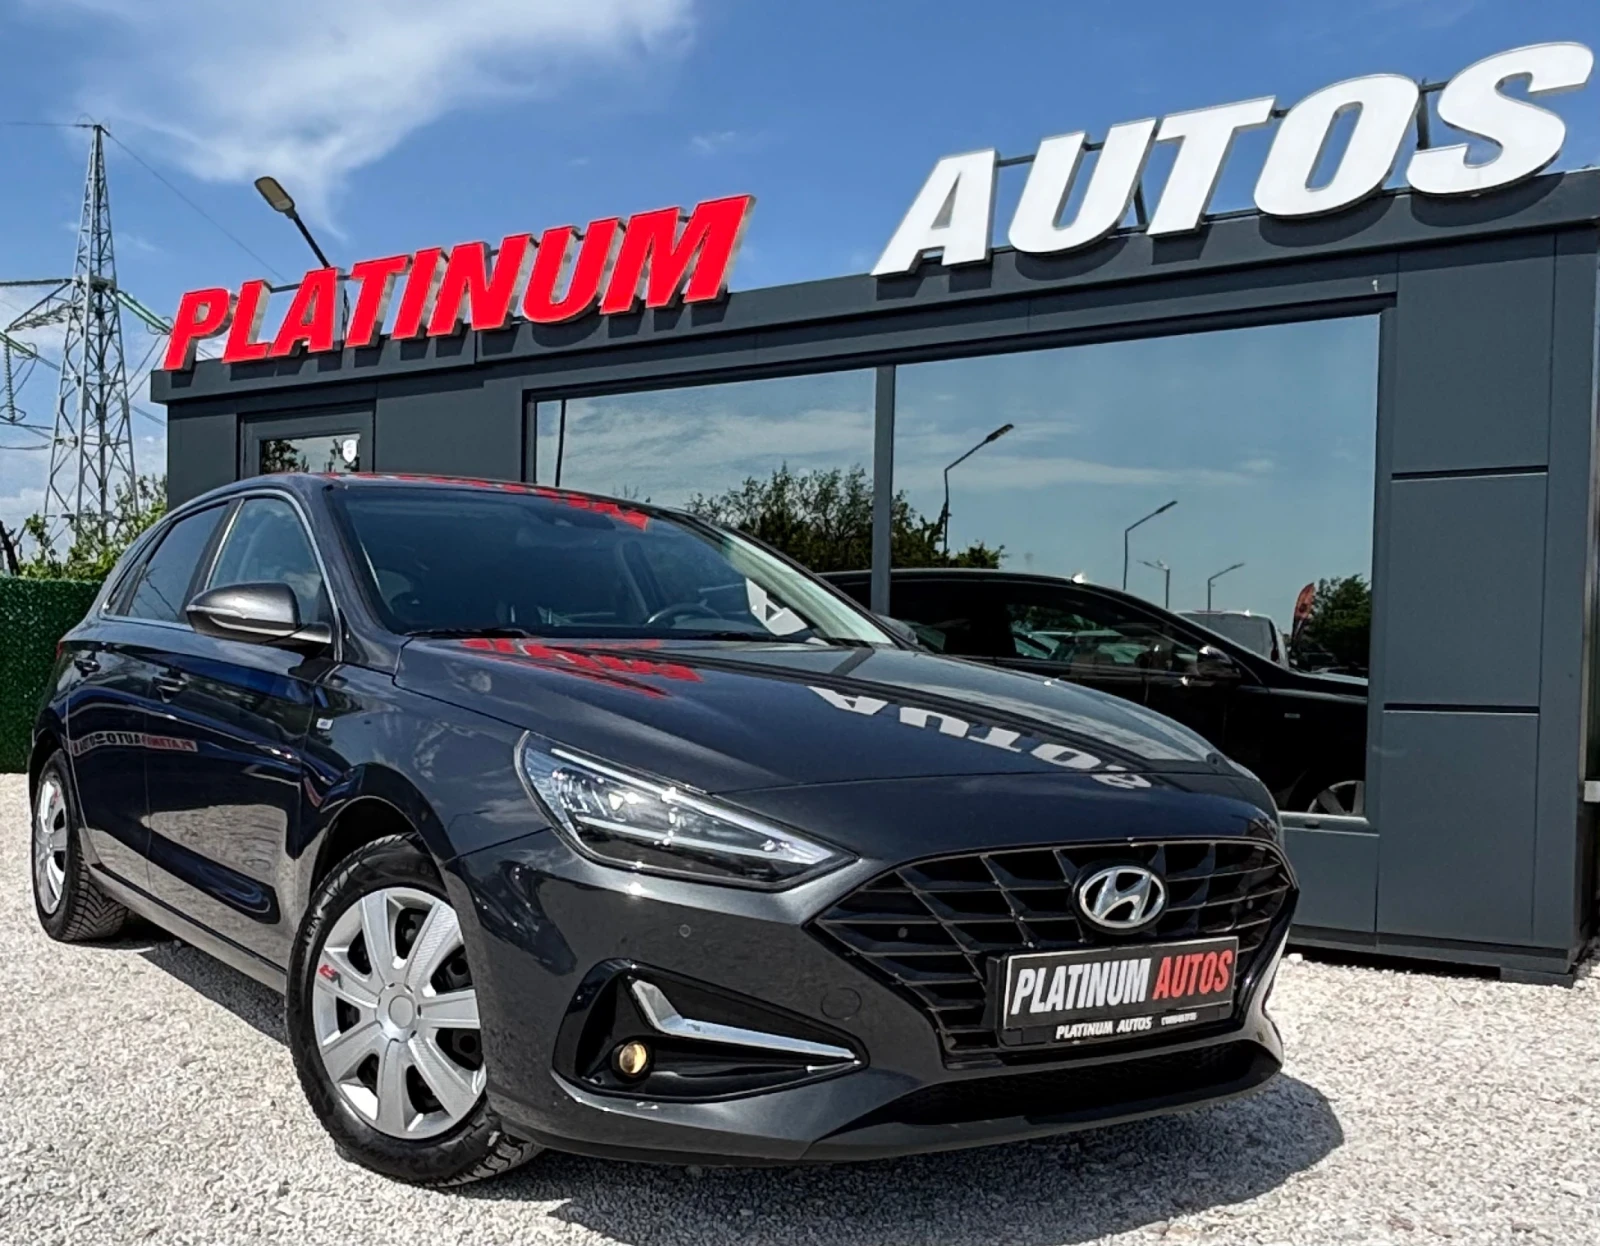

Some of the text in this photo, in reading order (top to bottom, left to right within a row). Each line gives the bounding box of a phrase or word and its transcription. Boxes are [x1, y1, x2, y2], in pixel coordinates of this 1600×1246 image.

[163, 41, 1595, 371] PLATINUM AUTOS
[1010, 949, 1233, 1016] PLATINUM AUTOS
[1055, 1020, 1114, 1040] PLATINUM
[1116, 1016, 1154, 1033] AUTOS
